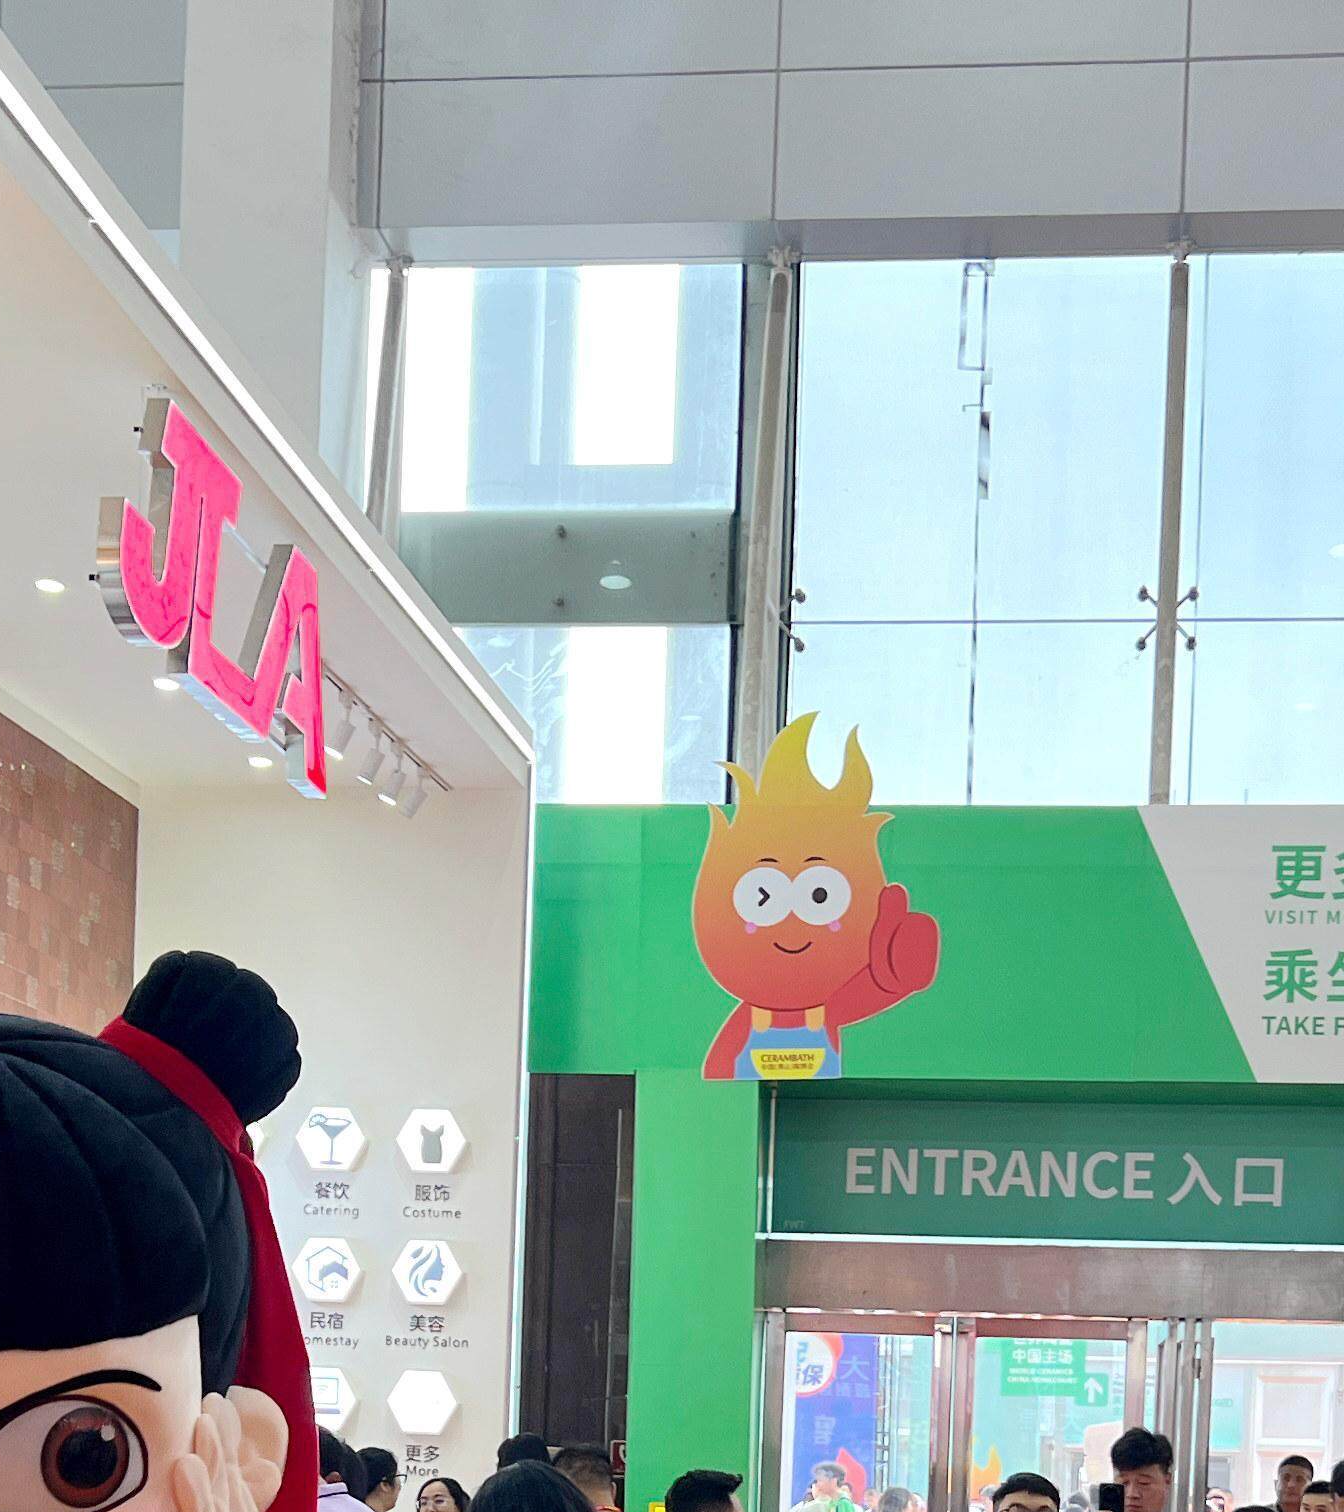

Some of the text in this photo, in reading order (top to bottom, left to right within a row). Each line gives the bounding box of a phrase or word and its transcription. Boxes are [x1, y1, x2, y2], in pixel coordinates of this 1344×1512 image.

[1264, 909, 1319, 925] VISIT
[1261, 1015, 1326, 1036] TAKE
[845, 1147, 1285, 1207] ENTRANCE 入口
[314, 1181, 352, 1201] 餐饮
[414, 1183, 451, 1203] 服饰
[303, 1203, 360, 1220] Catering
[402, 1206, 462, 1220] Costume
[309, 1311, 345, 1330] 民宿
[408, 1314, 446, 1334] 美容
[304, 1335, 360, 1350] omestay
[385, 1335, 470, 1349] Beauty Salon
[404, 1444, 441, 1463] 更多
[405, 1465, 440, 1478] More
